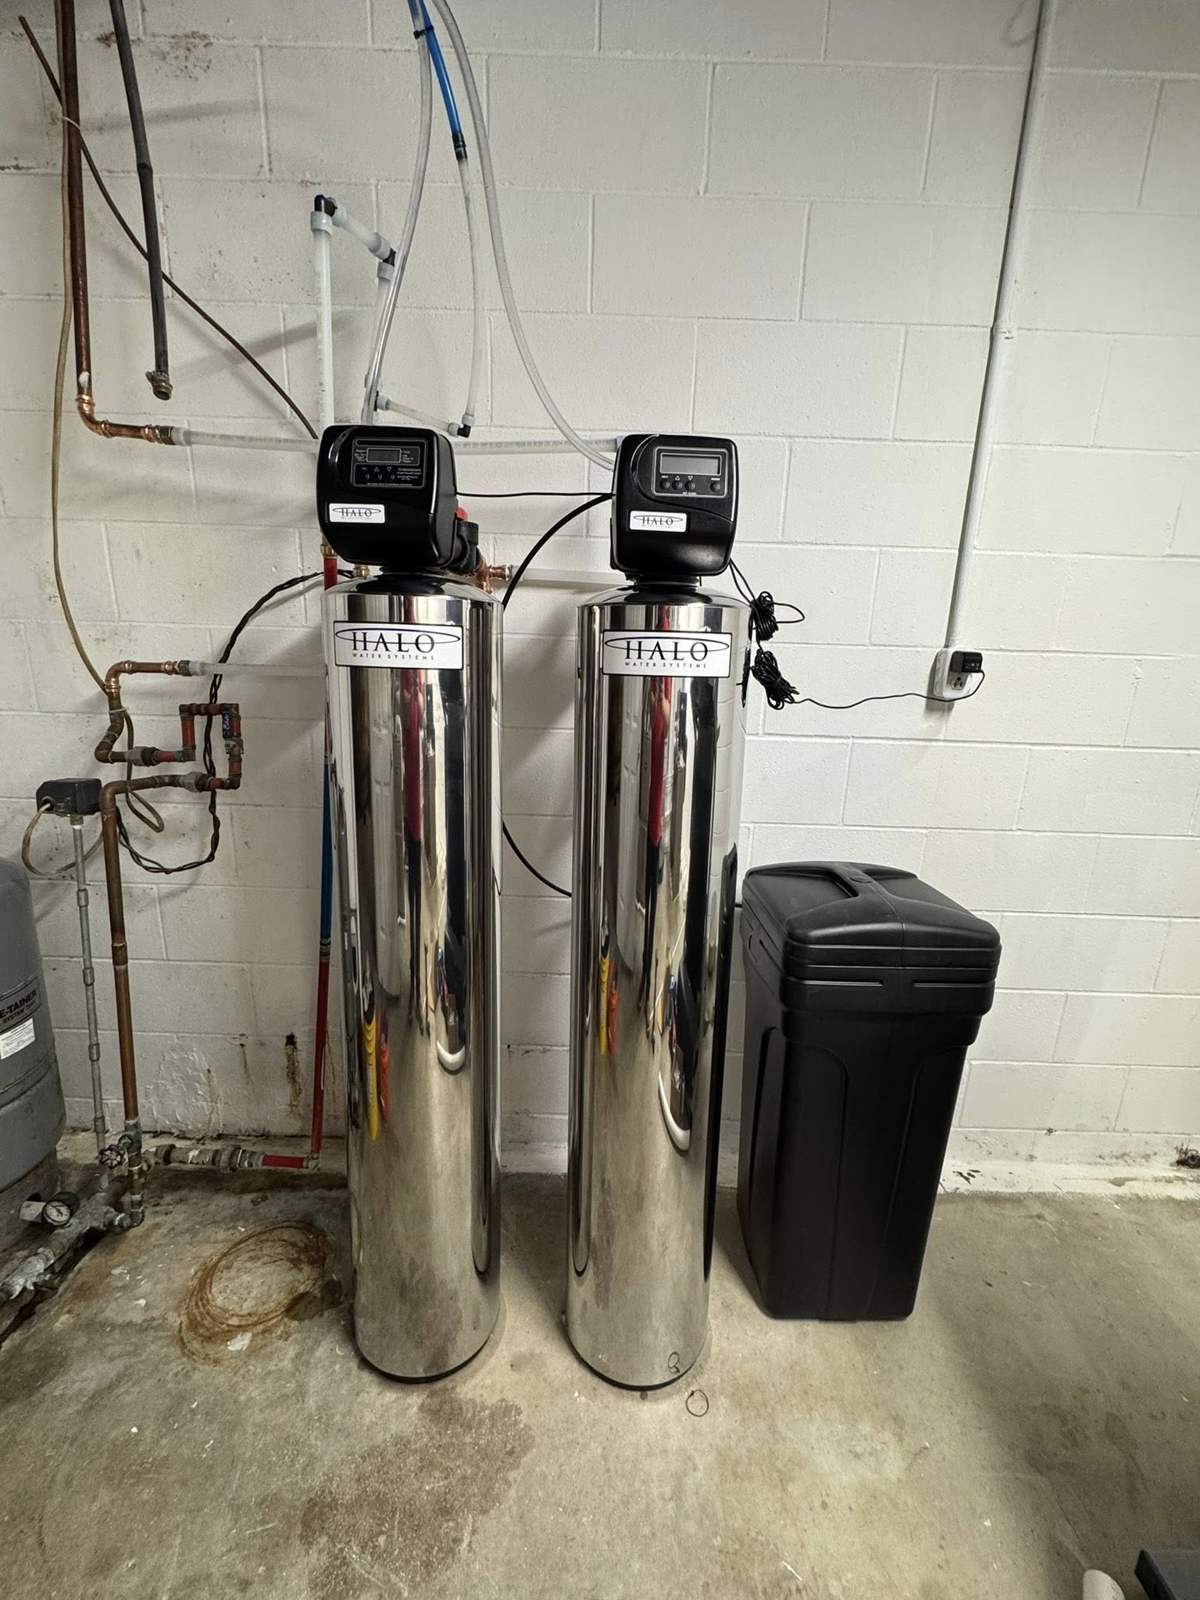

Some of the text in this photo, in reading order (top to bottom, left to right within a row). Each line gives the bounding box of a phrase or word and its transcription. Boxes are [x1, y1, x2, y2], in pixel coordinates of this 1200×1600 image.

[341, 508, 372, 518] HALO
[641, 515, 674, 526] HALO
[352, 631, 435, 654] HALO
[625, 640, 708, 662] HALO
